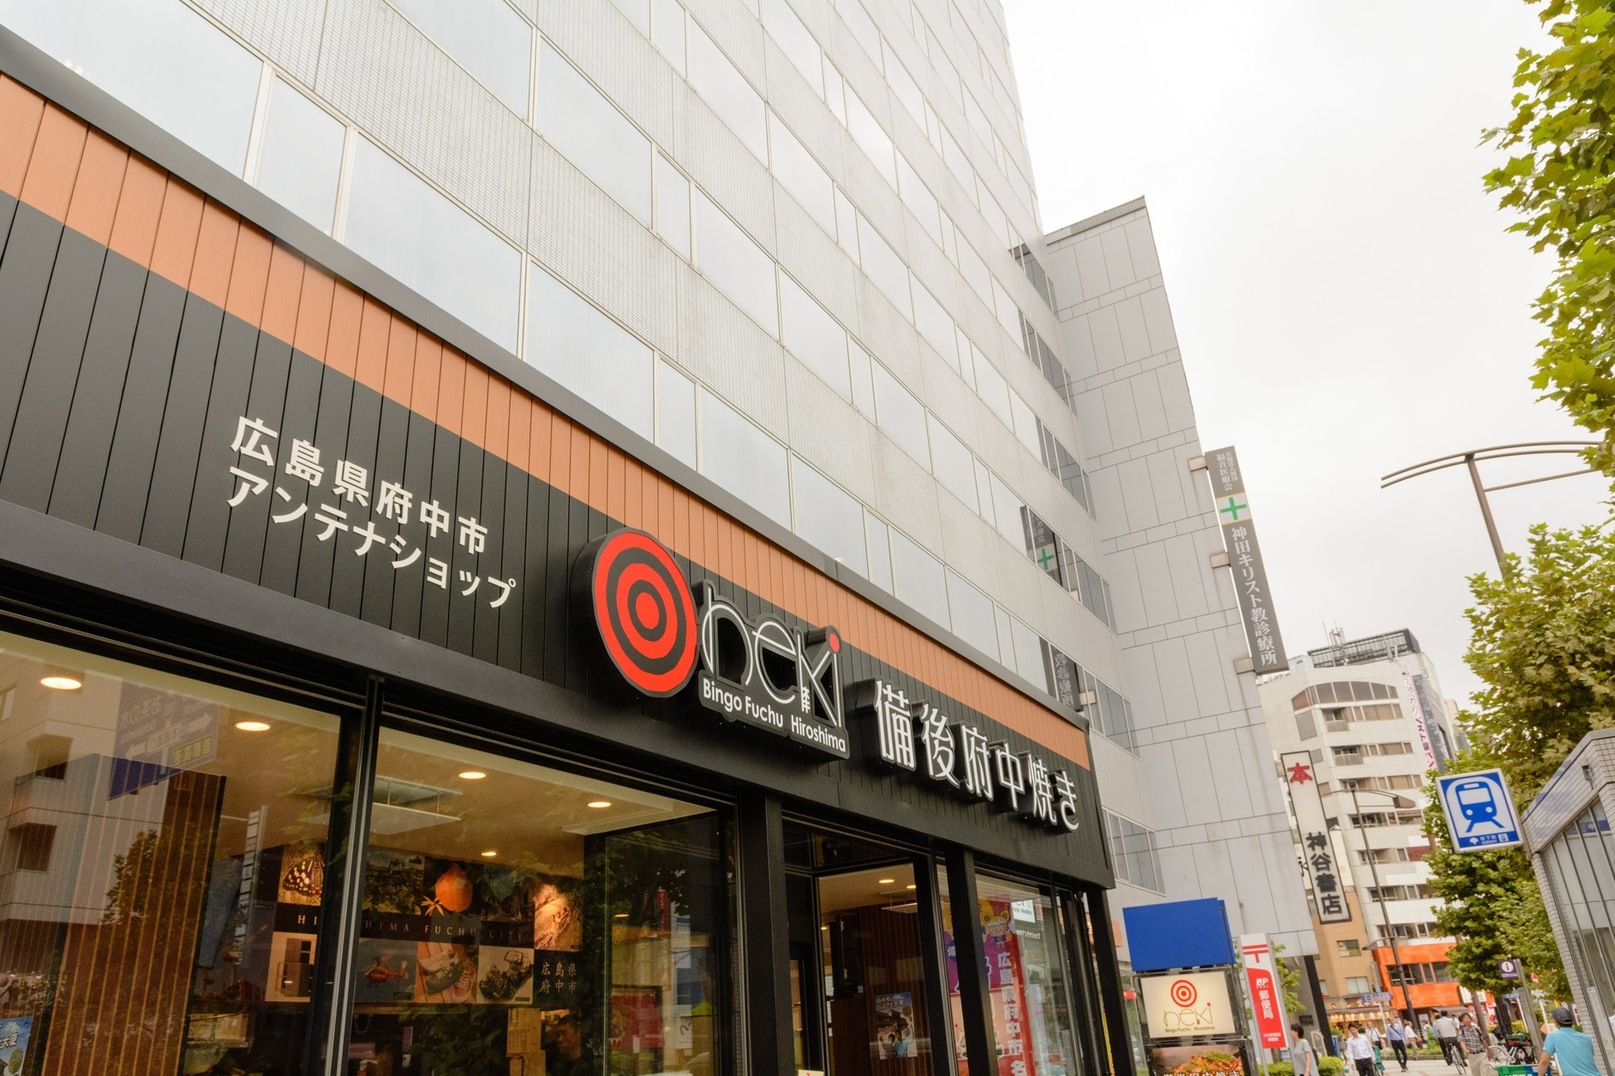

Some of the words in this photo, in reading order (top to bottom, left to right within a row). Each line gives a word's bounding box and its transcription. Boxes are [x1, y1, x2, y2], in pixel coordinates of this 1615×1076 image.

[230, 415, 488, 555] 広島県府中市
[226, 466, 517, 608] アンテナショップ
[1231, 525, 1278, 666] 神田キリスト教診療所
[702, 678, 743, 713] Bingo
[745, 695, 784, 728] Fuchu
[790, 714, 847, 753] Hiroshima
[873, 678, 1080, 832] 備後府中焼き
[1287, 762, 1313, 785] 本
[1305, 831, 1343, 915] 神谷書店
[424, 924, 477, 936] FUCHU
[489, 929, 523, 941] CITY
[541, 961, 577, 977] 広島県
[539, 979, 577, 995] 府中市
